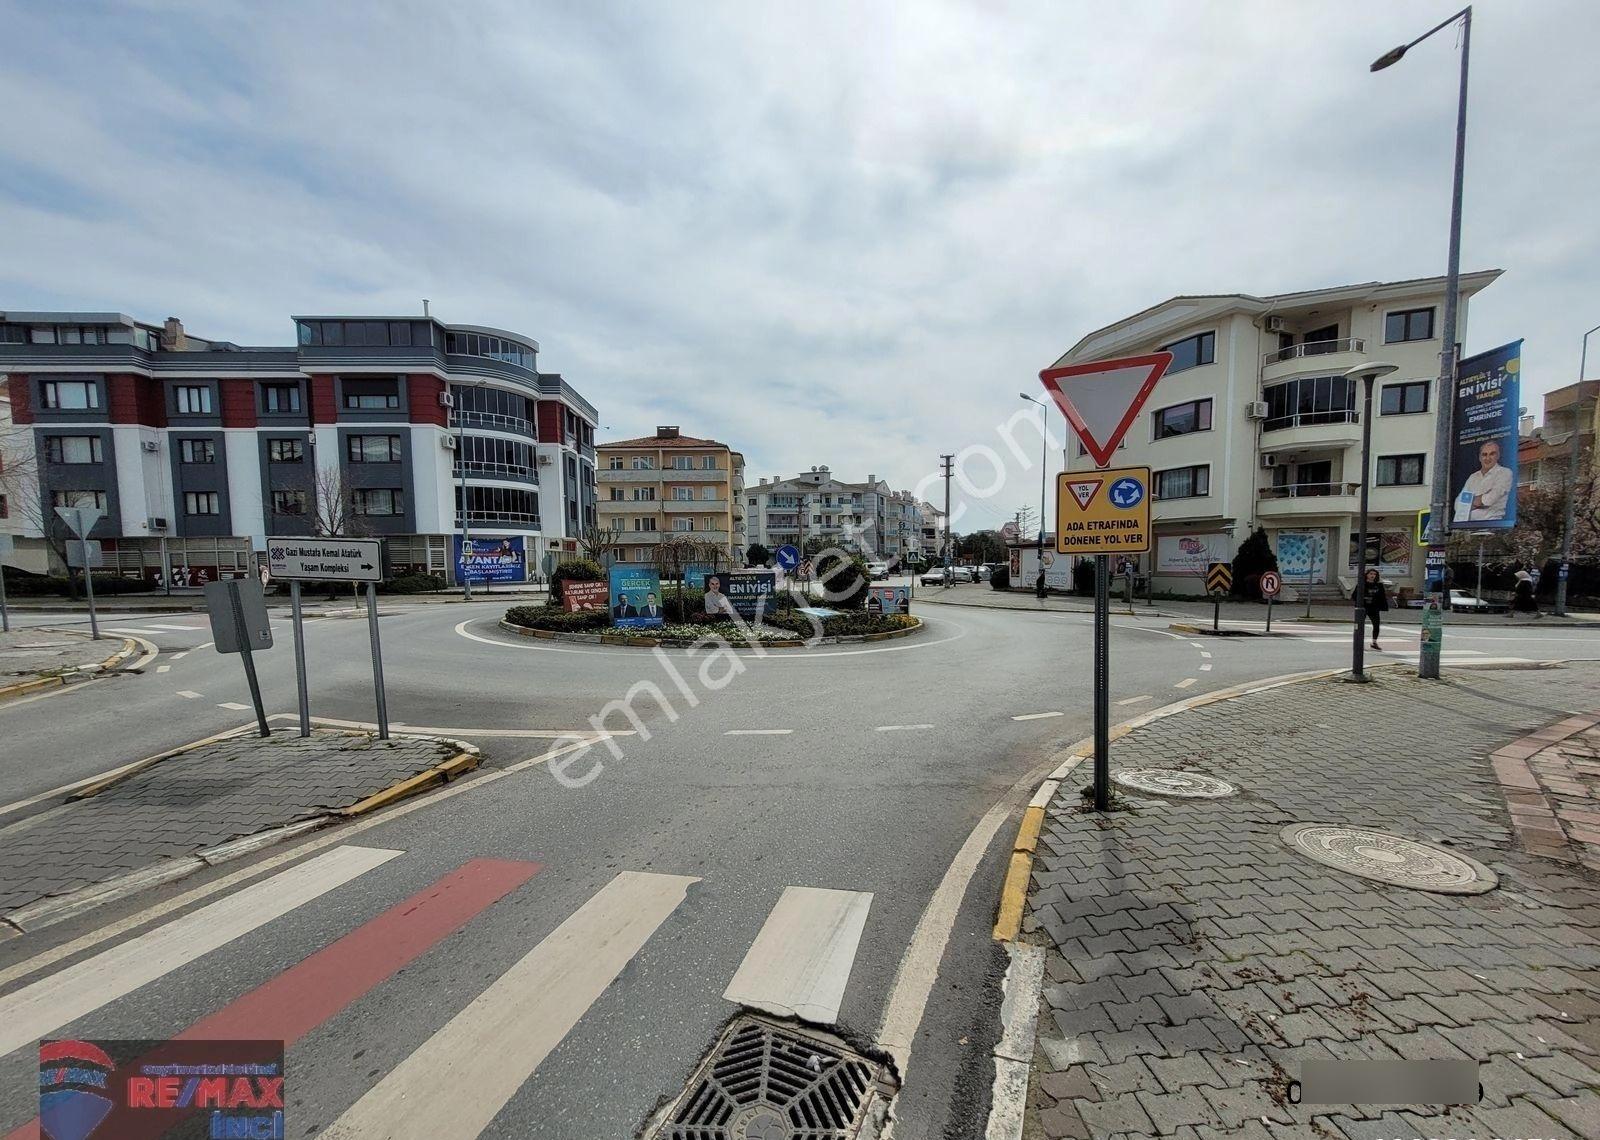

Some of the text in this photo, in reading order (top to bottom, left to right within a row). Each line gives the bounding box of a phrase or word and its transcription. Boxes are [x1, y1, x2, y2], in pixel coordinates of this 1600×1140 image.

[1459, 374, 1502, 398] EN İYİSİ
[1066, 519, 1139, 531] ADA ETRAFINDA
[1064, 533, 1143, 546] DÖNENE YOL VER
[285, 547, 362, 558] Gazi Mustafa Kemal Atatürk
[300, 561, 319, 574] Yaşam
[320, 562, 350, 574] Kompleksi
[729, 579, 772, 594] EN İYİSİ
